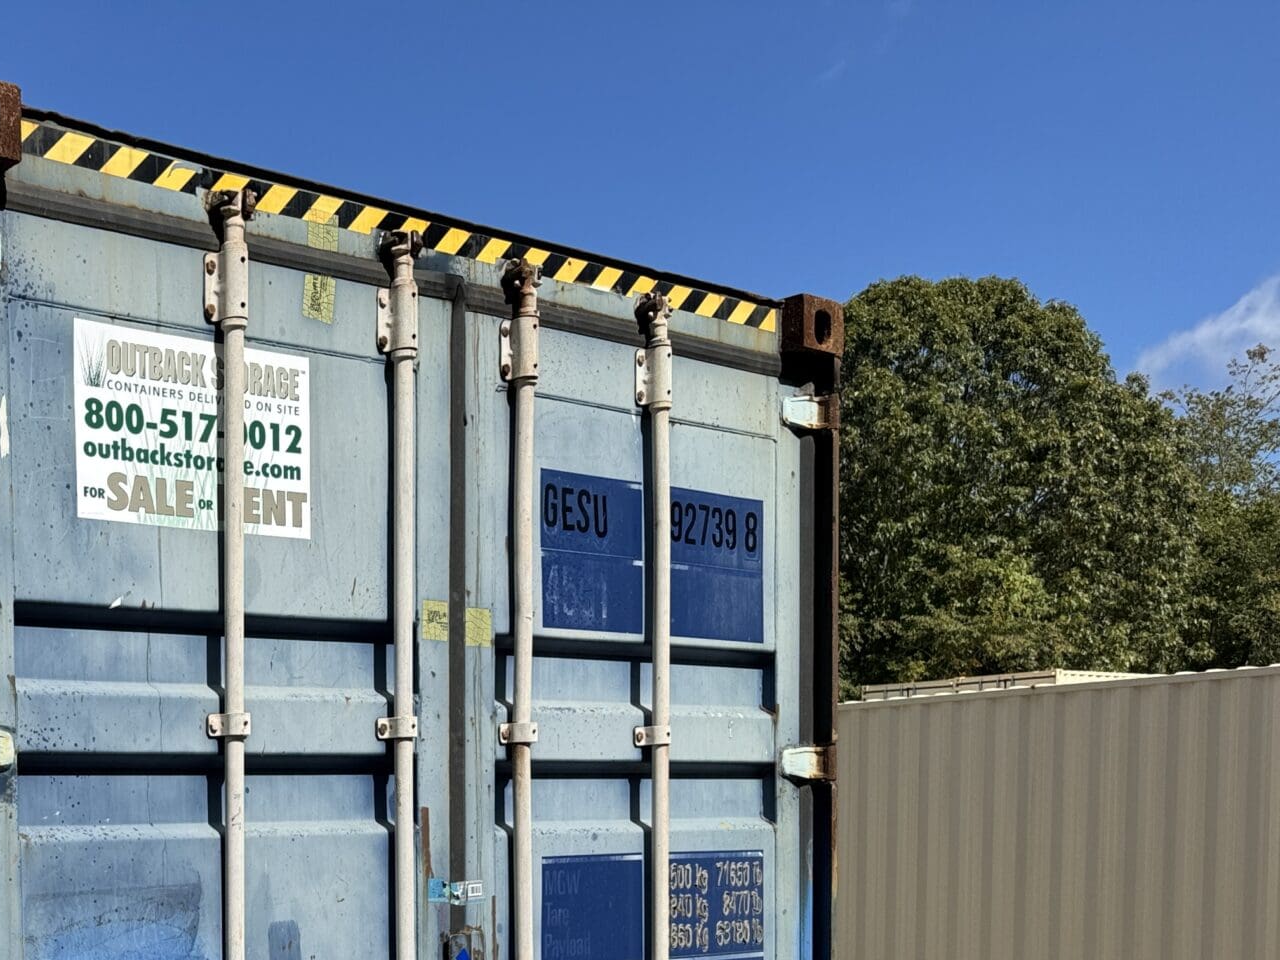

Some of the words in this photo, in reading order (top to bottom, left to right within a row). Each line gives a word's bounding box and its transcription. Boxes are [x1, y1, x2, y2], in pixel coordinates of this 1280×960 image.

[106, 339, 207, 389] OUTBACK
[211, 356, 300, 401] SRAGE
[106, 380, 184, 400] CONTAINERS
[189, 392, 251, 410] DELIVD
[257, 401, 272, 413] ON
[277, 404, 300, 416] SITE
[84, 397, 303, 454] 800-517-012
[83, 438, 302, 481] outbackstorae.com
[83, 486, 106, 500] FOR
[106, 471, 195, 518] SALE
[198, 499, 214, 511] OR
[243, 487, 308, 528] ENT
[544, 483, 608, 538] GESU
[671, 500, 737, 550] 92739
[744, 512, 758, 552] 8
[671, 863, 692, 890] 500
[671, 893, 693, 918] 840
[671, 922, 693, 949] 660
